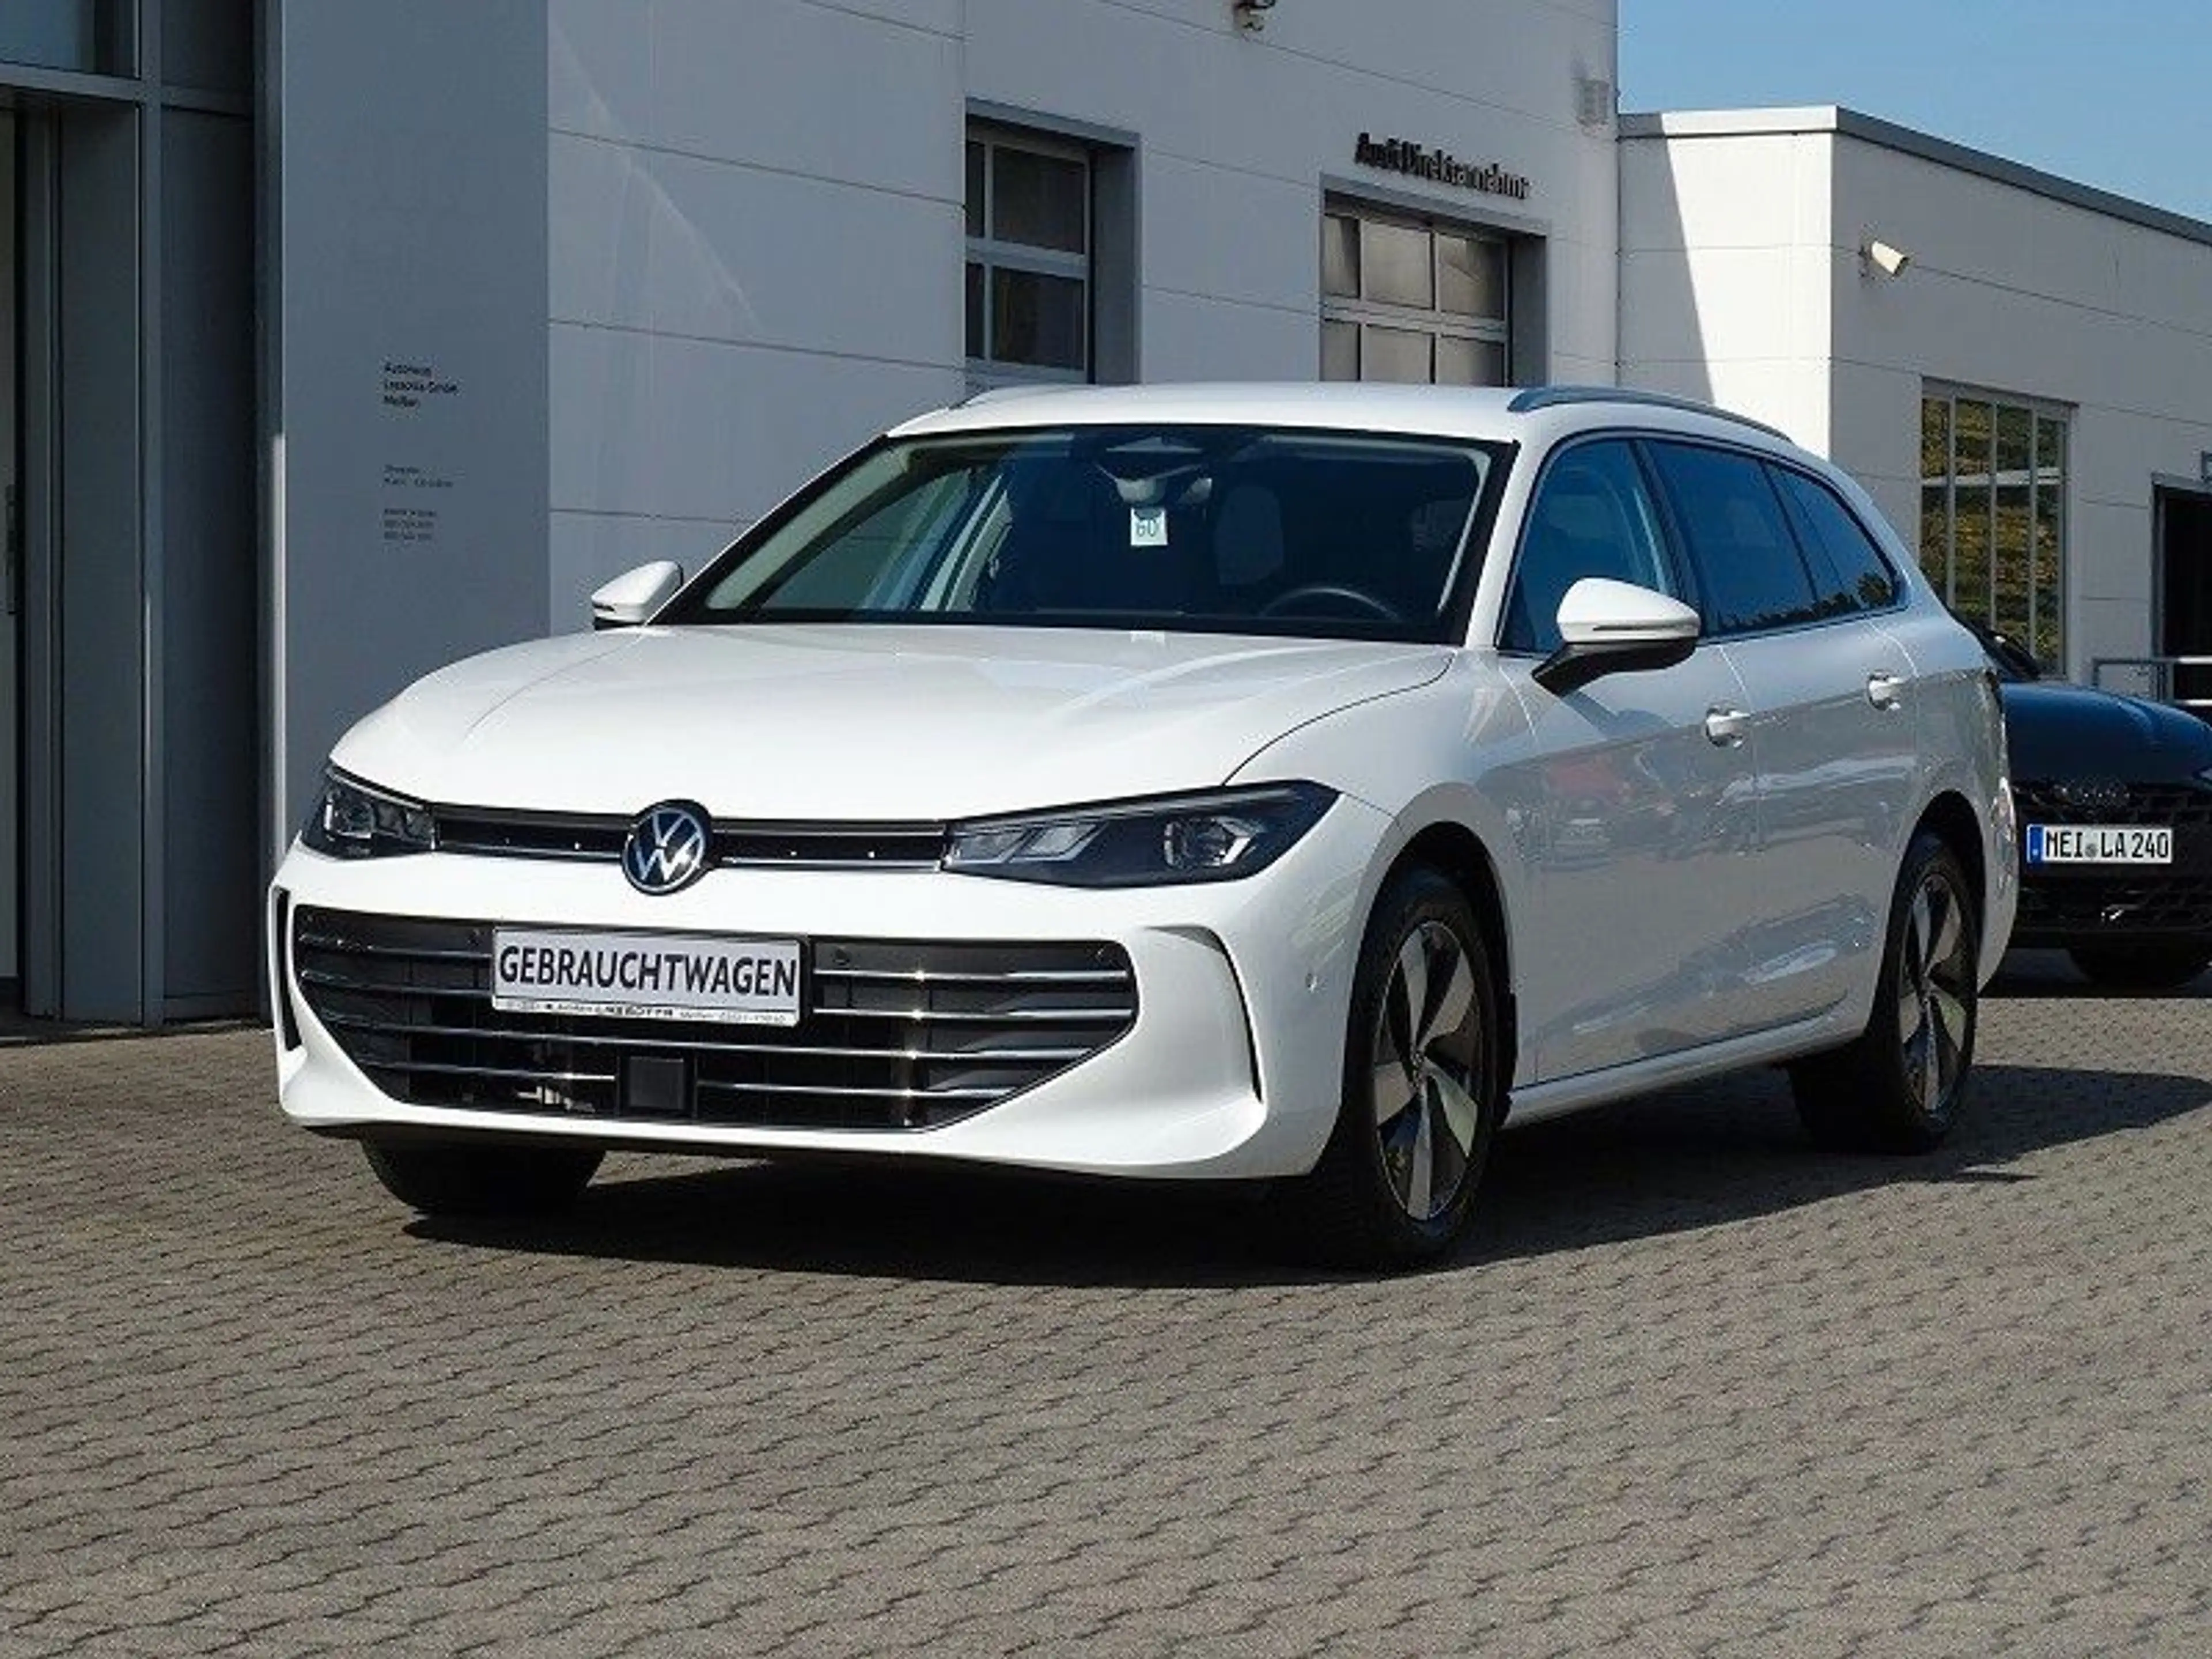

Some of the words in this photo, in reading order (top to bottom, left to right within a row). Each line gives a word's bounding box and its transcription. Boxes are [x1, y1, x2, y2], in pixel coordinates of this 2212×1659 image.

[624, 808, 703, 891] VW
[2046, 832, 2083, 858] MEI
[2100, 832, 2127, 858] LA
[2131, 832, 2169, 858] 240
[499, 945, 797, 997] GEBRAUCHTWAGEN
